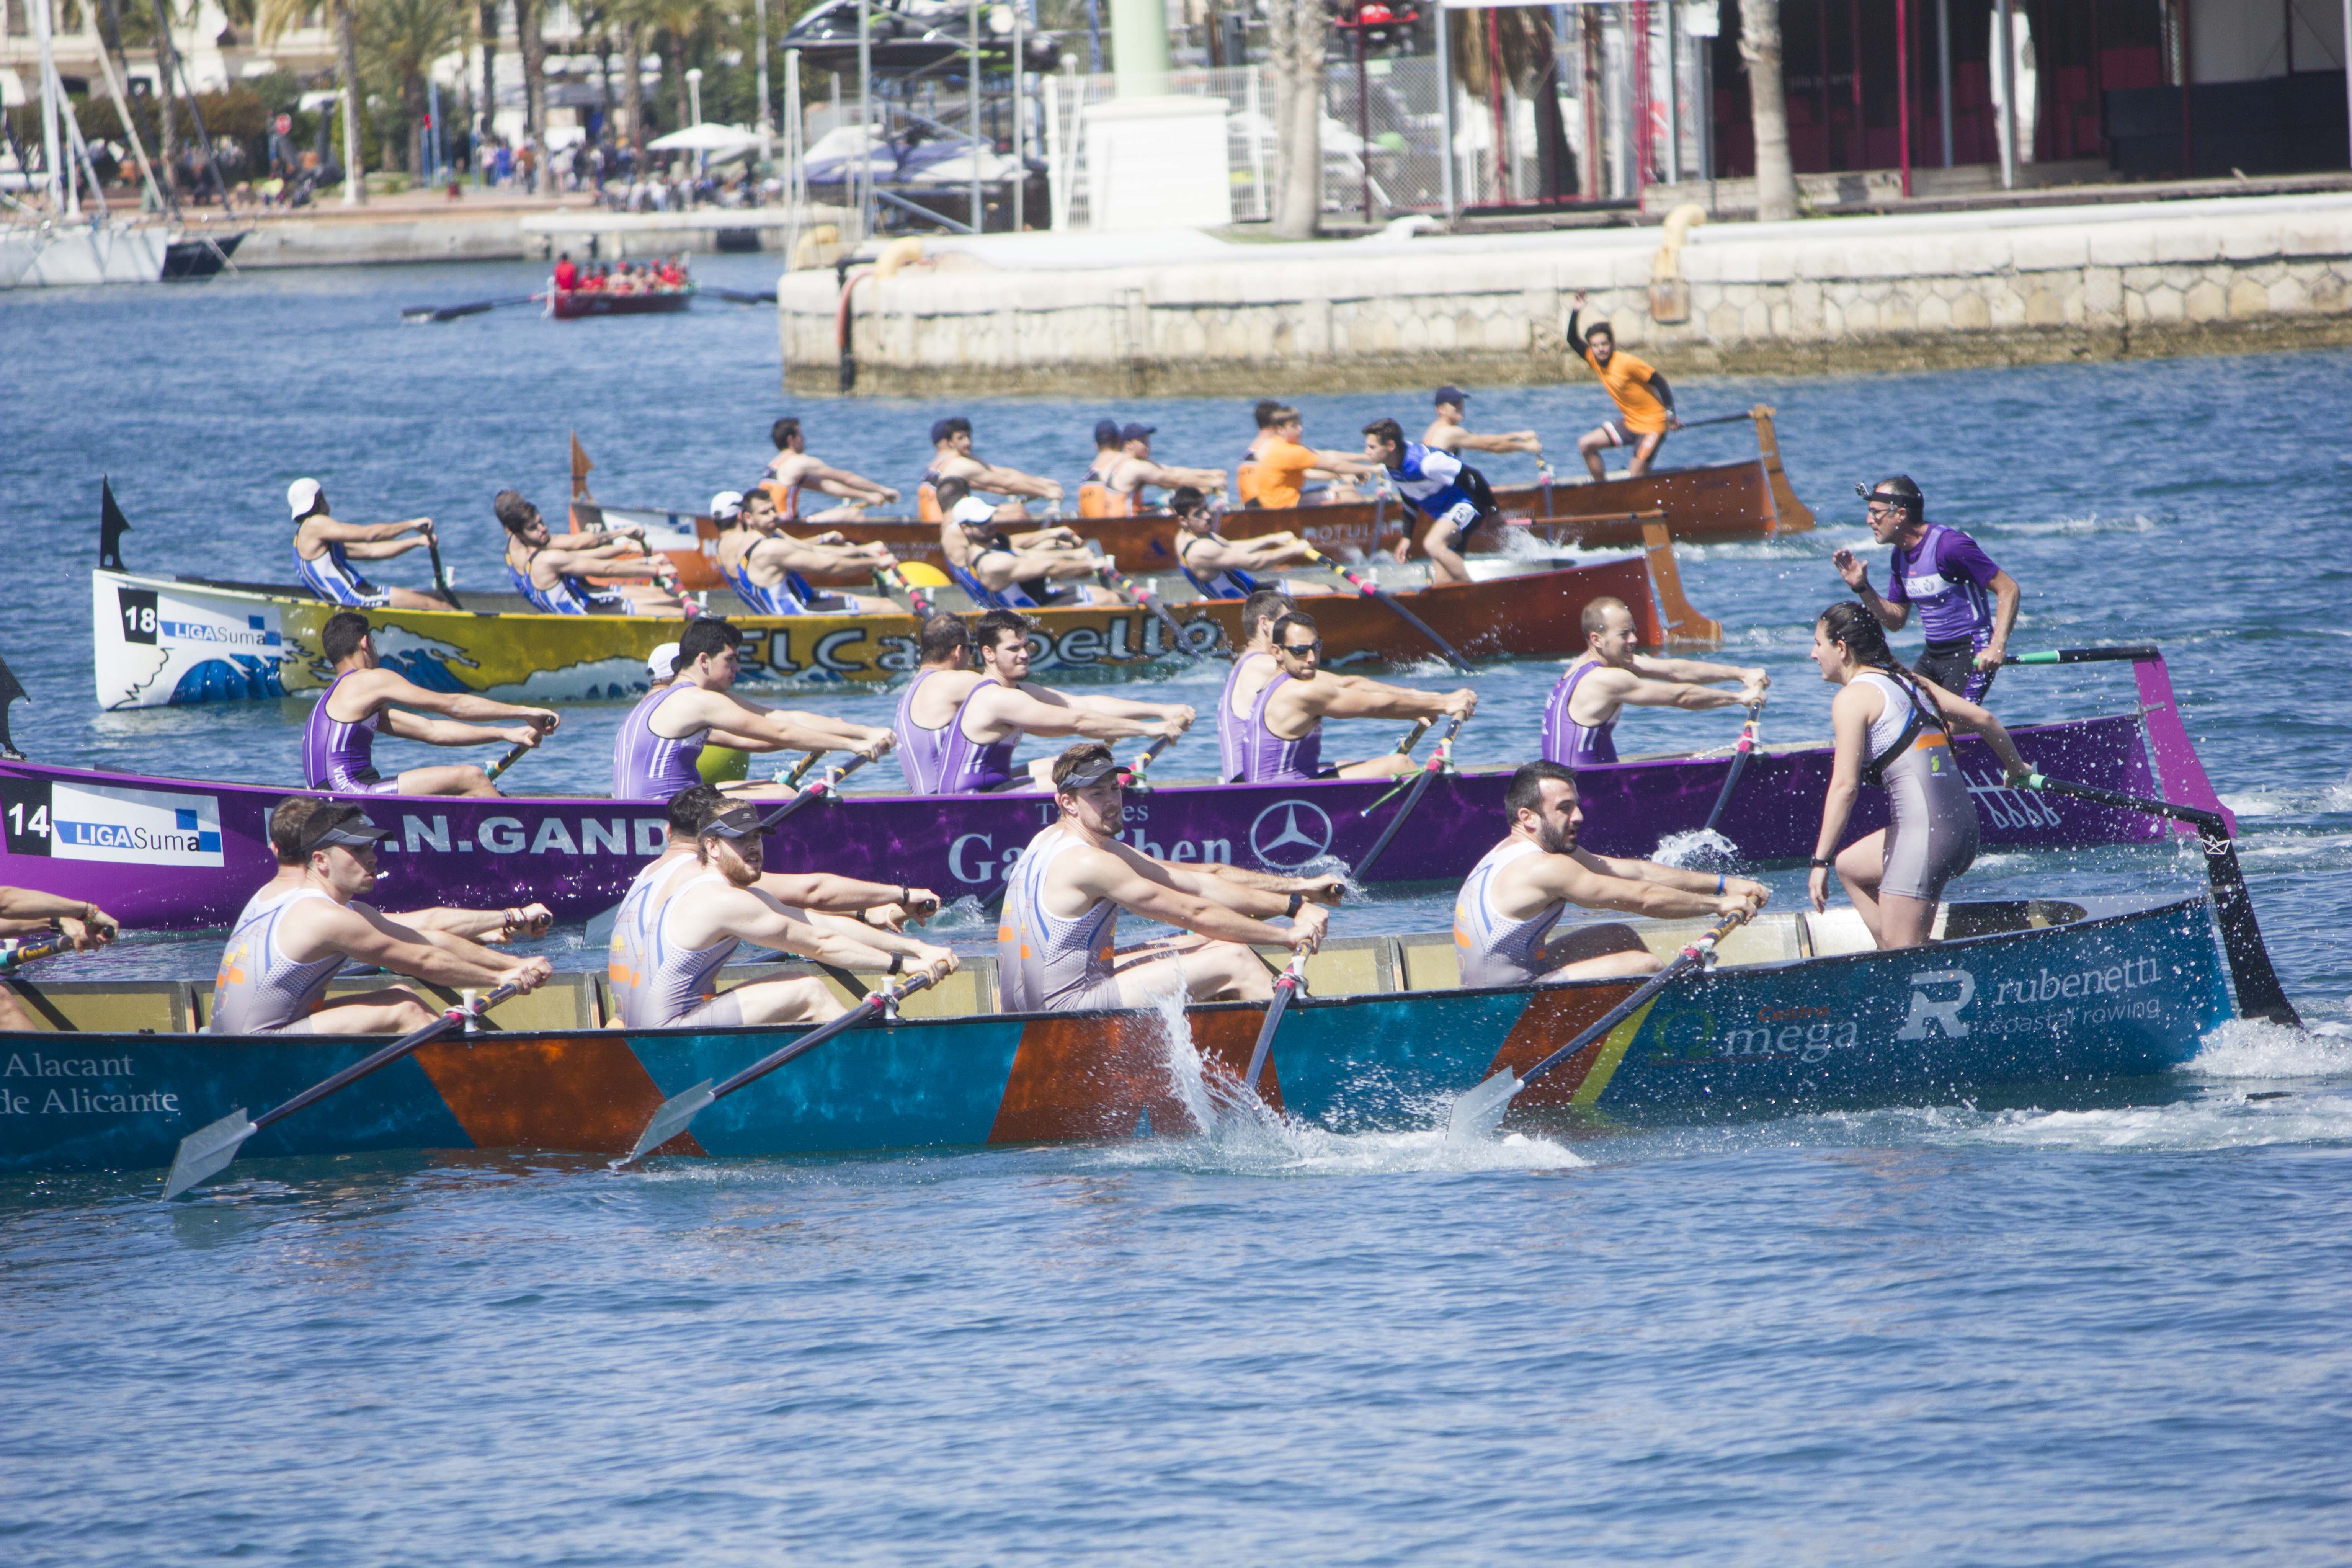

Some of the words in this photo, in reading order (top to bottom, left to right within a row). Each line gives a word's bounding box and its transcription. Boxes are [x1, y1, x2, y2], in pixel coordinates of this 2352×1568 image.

[125, 605, 157, 634] 18
[8, 802, 51, 838] 14
[1995, 954, 2161, 1006] rubenetti
[1757, 1005, 1830, 1023] Centro
[1990, 1007, 2075, 1036] coastal
[2082, 996, 2160, 1024] rowing
[4, 1052, 135, 1077] Alacant
[0, 1088, 30, 1115] de
[40, 1087, 180, 1114] Alicante
